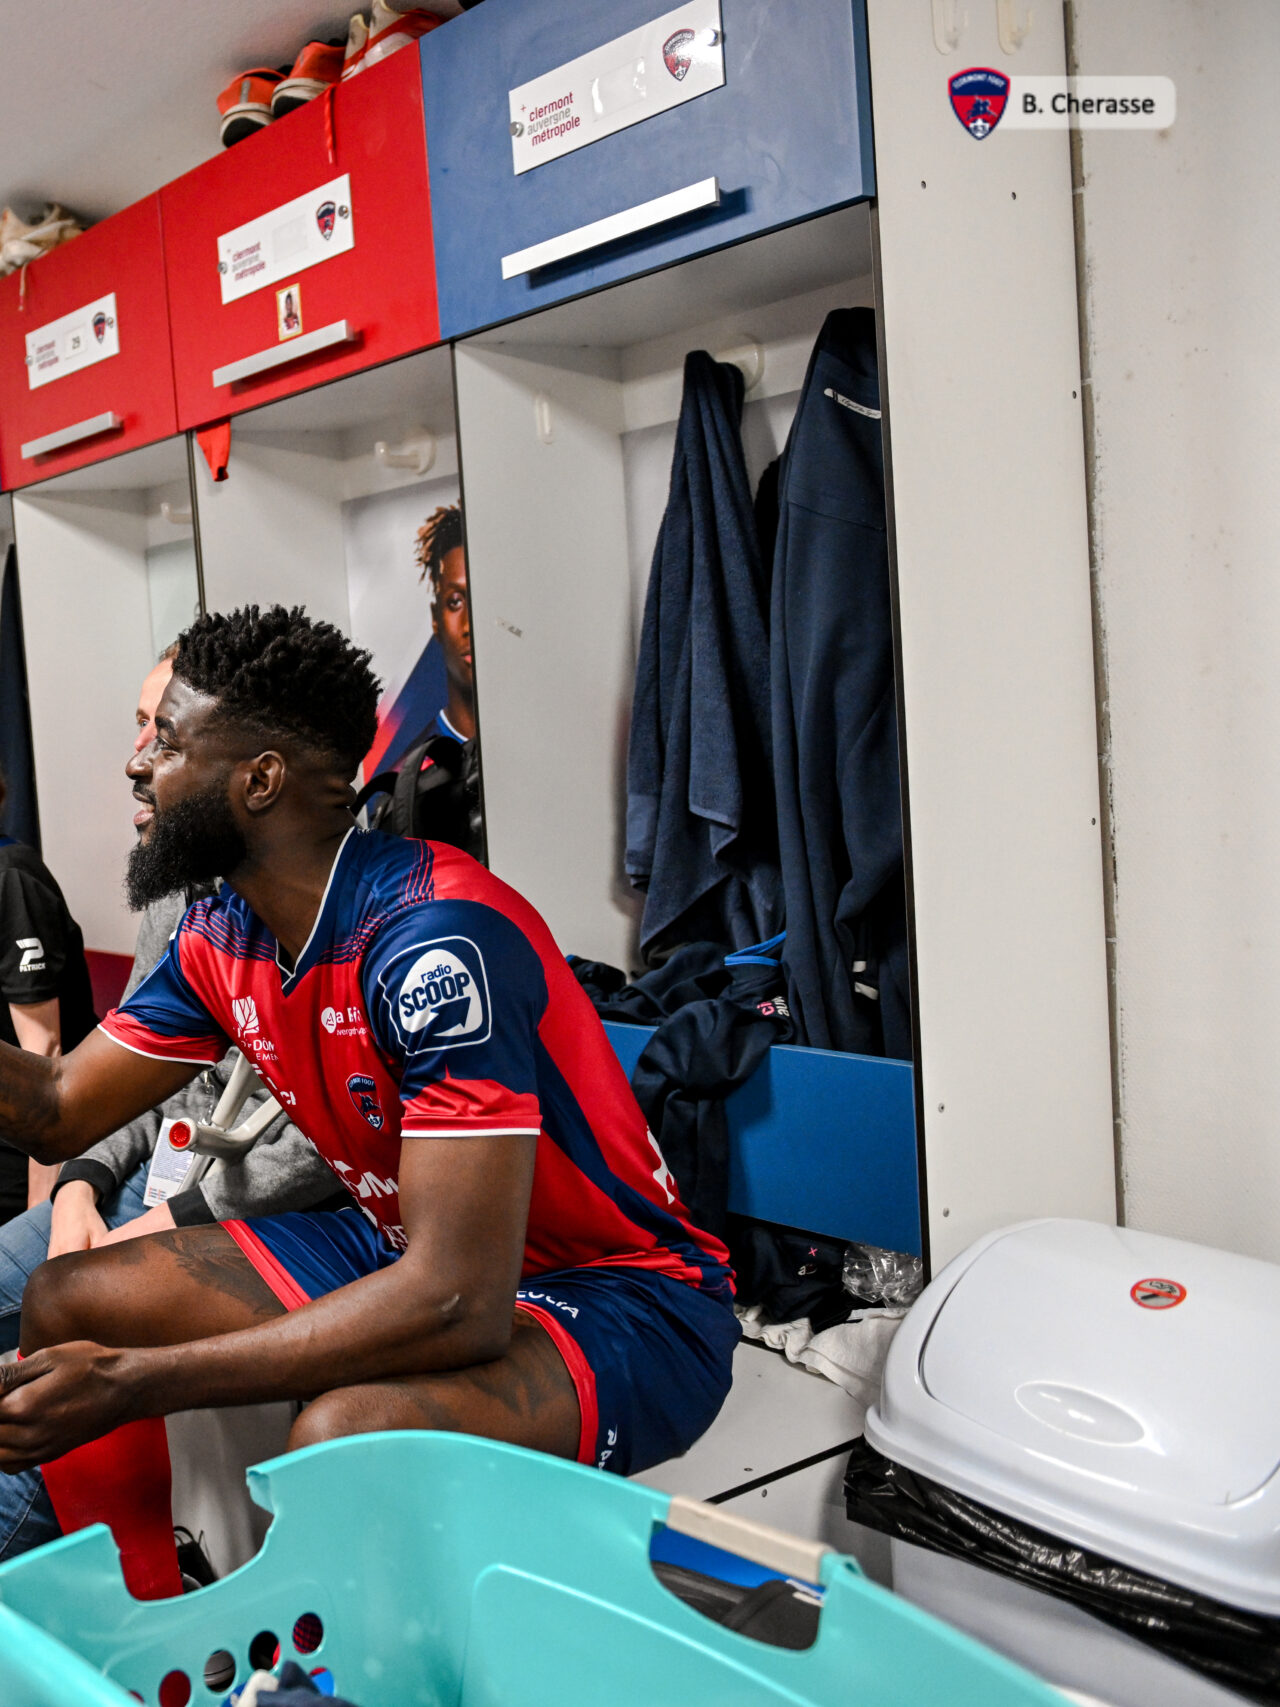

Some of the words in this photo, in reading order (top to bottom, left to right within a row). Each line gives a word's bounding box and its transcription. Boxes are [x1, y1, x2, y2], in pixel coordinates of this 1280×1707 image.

[527, 107, 571, 136] auvergne
[529, 91, 574, 122] clermont
[532, 116, 581, 147] métropole
[421, 964, 452, 983] radio
[400, 972, 470, 1017] SCOOP
